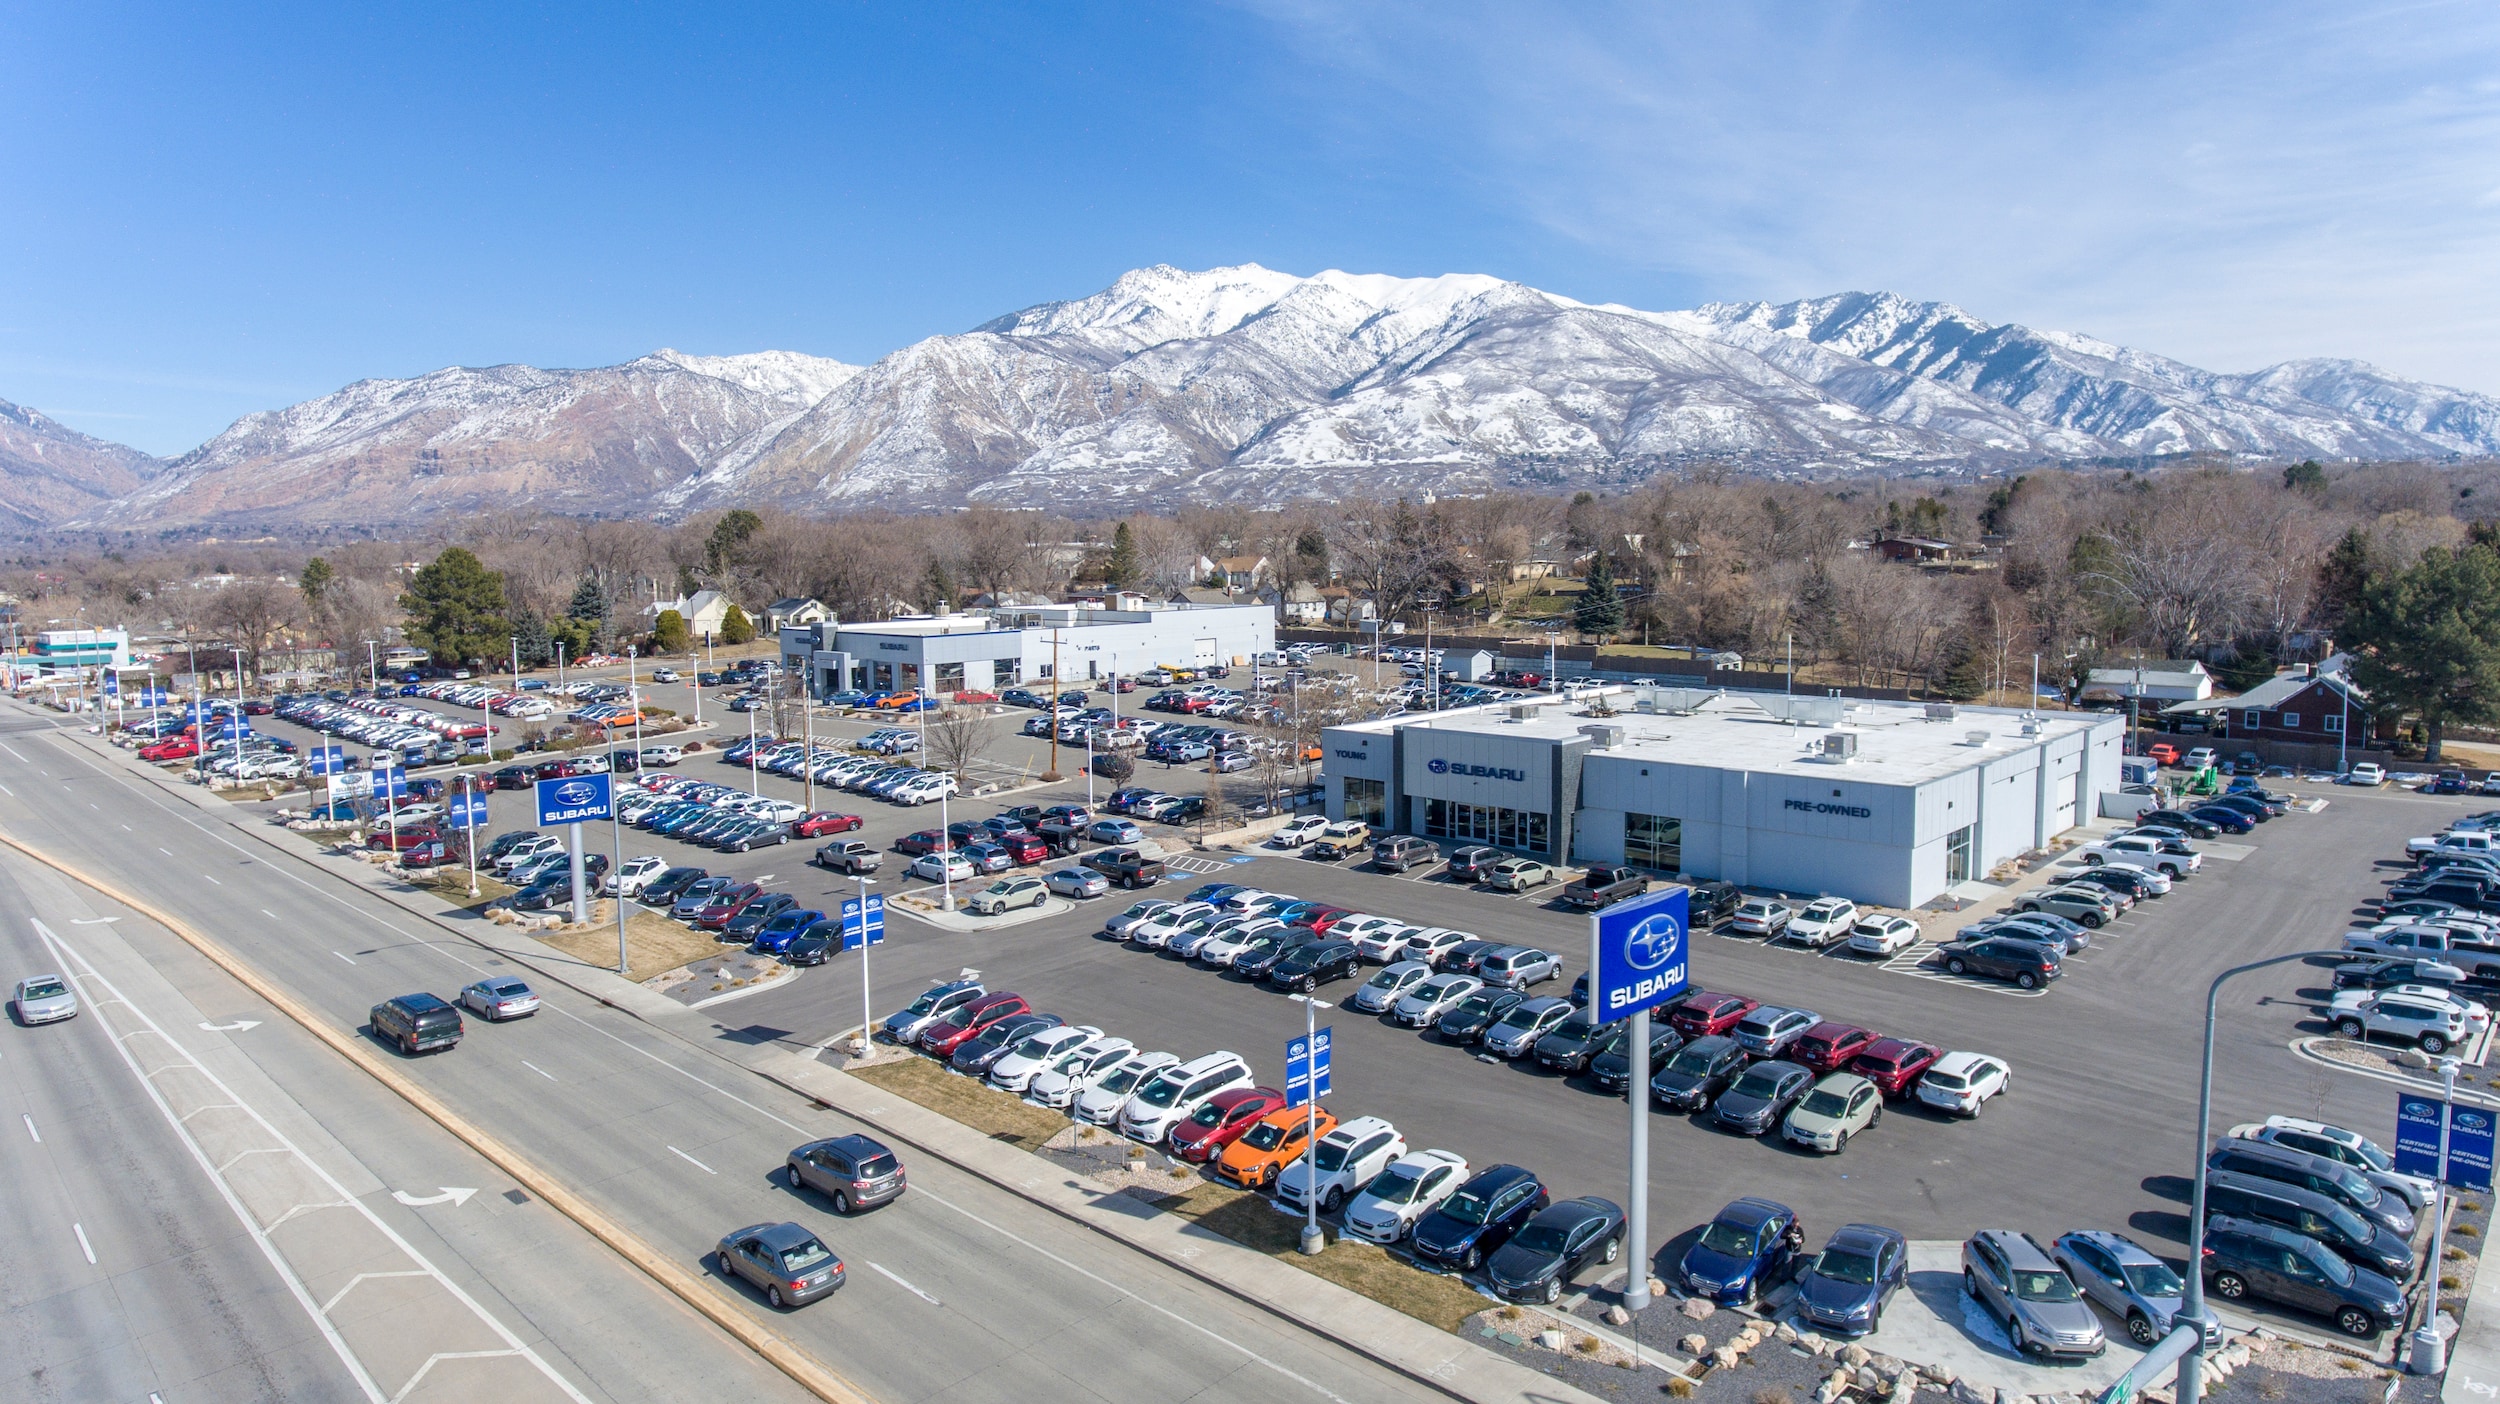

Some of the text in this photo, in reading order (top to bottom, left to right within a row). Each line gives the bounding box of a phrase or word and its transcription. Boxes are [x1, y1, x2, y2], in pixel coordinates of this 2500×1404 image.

[1335, 749, 1367, 760] YOUNG
[1450, 762, 1525, 782] SUBARU
[545, 805, 607, 822] SUBARU
[1784, 799, 1871, 818] PRE-OWNED
[1610, 962, 1685, 1009] SUBARU
[1287, 1053, 1307, 1063] SUBARU
[2399, 1113, 2439, 1126] SUBARU
[2451, 1124, 2492, 1137] SUBARU
[2399, 1138, 2437, 1150] CERTIFIED
[2397, 1144, 2439, 1158] PRE-OWNED
[2451, 1149, 2490, 1162] CERTIFIED
[2449, 1155, 2491, 1170] PRE-OWNED
[2412, 1169, 2437, 1183] Young
[2465, 1181, 2491, 1194] Young
